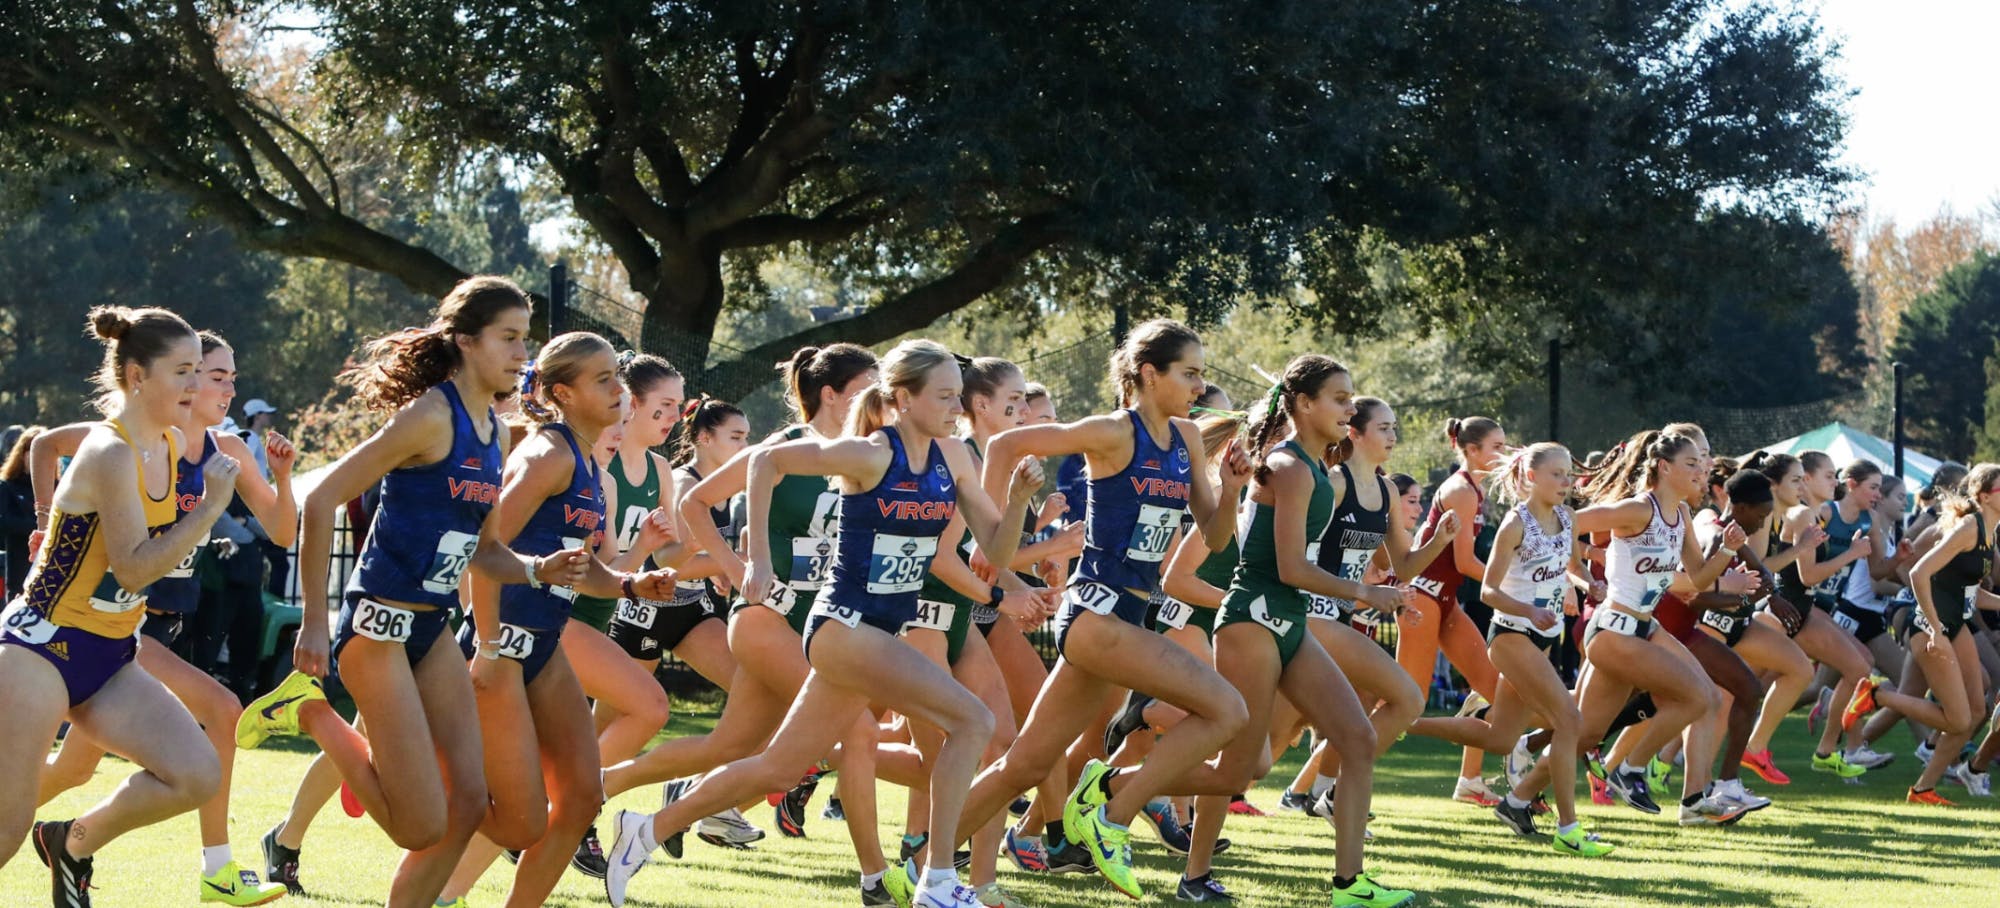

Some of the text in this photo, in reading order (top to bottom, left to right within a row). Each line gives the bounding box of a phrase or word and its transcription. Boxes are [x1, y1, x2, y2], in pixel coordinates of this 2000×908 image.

[1138, 525, 1173, 554] 307
[432, 553, 468, 585] 29
[878, 556, 927, 584] 295
[7, 606, 40, 638] 82
[359, 604, 407, 639] 296
[622, 599, 650, 624] 356
[1160, 600, 1181, 622] 40
[1609, 612, 1628, 631] 71
[1838, 615, 1852, 631] 10
[500, 625, 527, 655] 04
